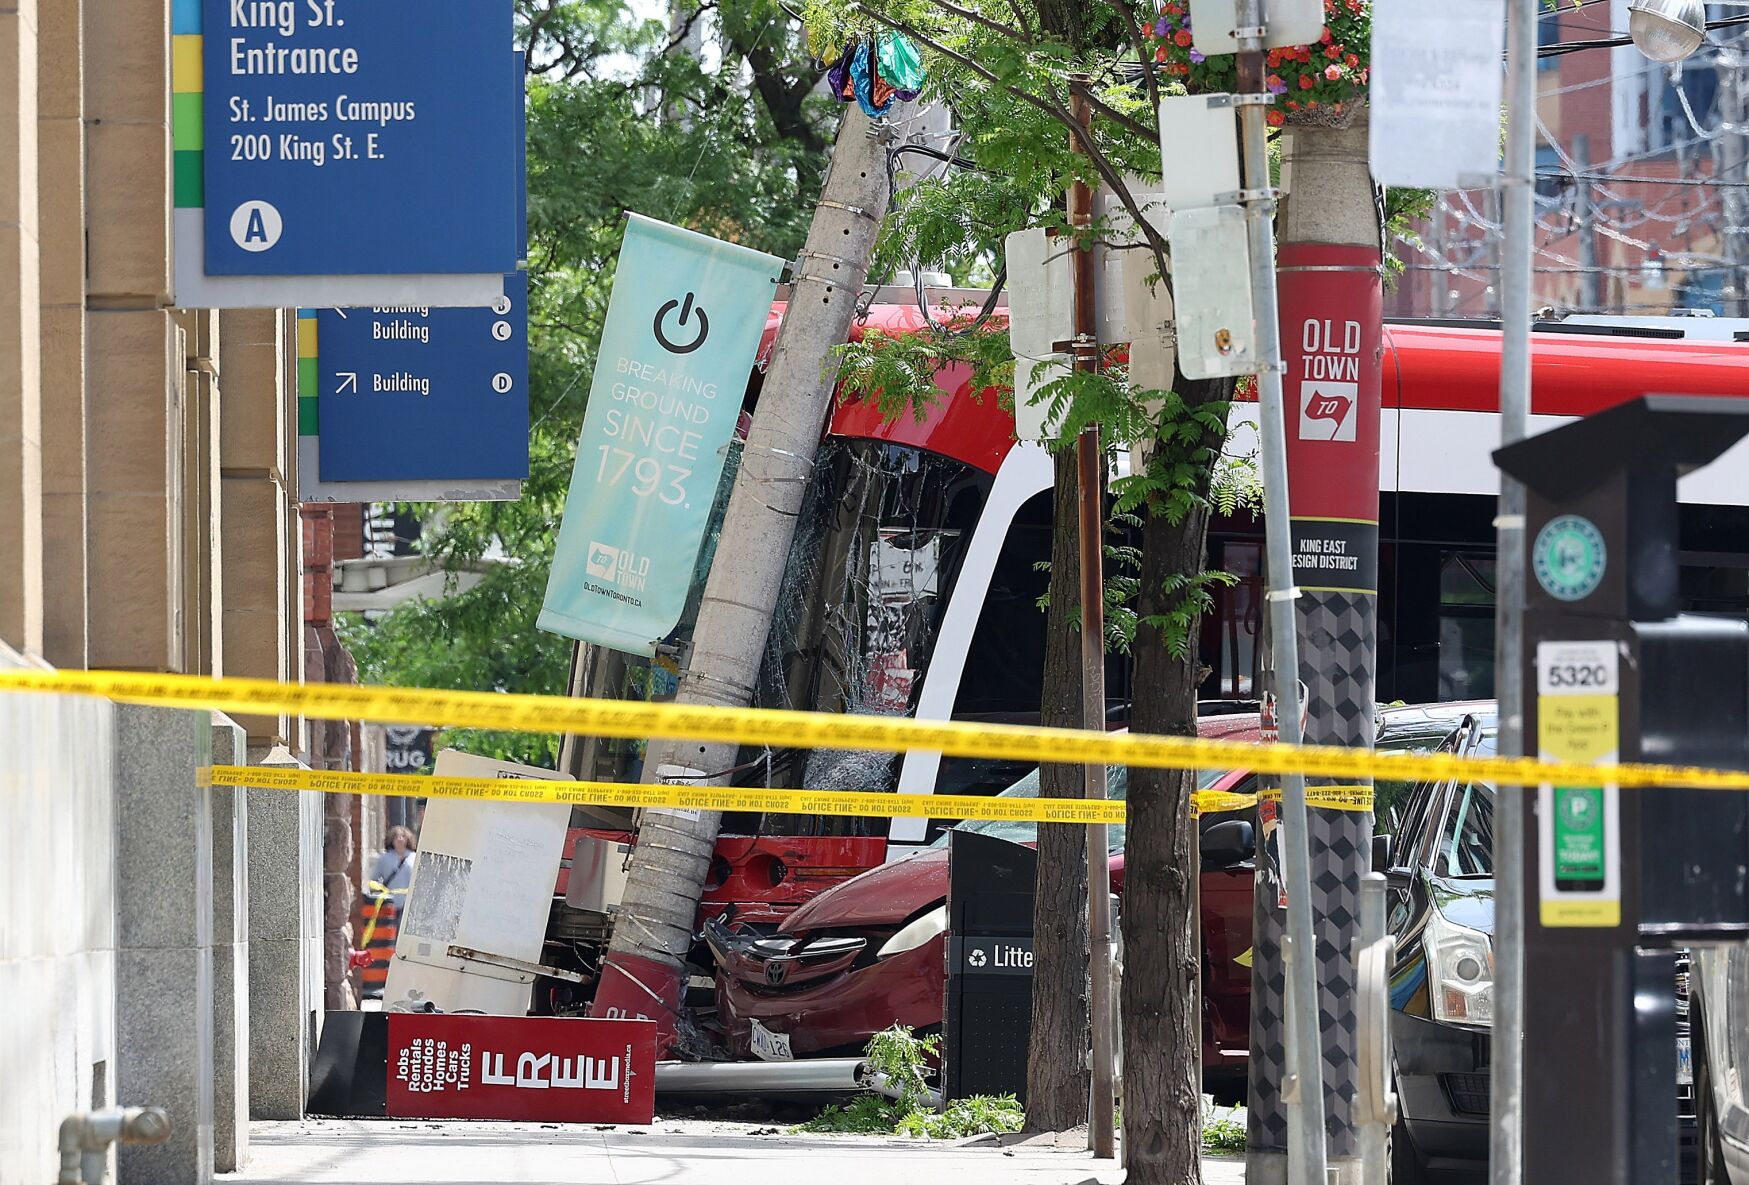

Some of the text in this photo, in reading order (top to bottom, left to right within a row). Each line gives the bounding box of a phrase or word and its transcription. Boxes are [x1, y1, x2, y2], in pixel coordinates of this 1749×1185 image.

[230, 0, 344, 36] King St.
[230, 38, 359, 74] Entrance
[229, 94, 416, 127] St. James Campus
[230, 133, 385, 167] 200 King St. E.
[244, 208, 268, 243] A
[372, 319, 505, 344] Building C
[1302, 318, 1362, 354] OLD
[372, 372, 508, 396] Building D
[616, 356, 718, 400] BREAKING
[1302, 354, 1360, 382] TOWN
[611, 382, 710, 424] GROUND
[1317, 400, 1338, 415] TO
[602, 409, 704, 461] SINCE
[596, 444, 690, 510] 1793.
[618, 550, 650, 576] OLD
[1292, 554, 1358, 570] ESIGN DISTRICT
[1300, 539, 1346, 554] KING EAST
[616, 570, 646, 592] TOWN
[994, 944, 1034, 968] Litte
[396, 1048, 409, 1082] Jobs
[408, 1038, 422, 1092] Rentals
[420, 1038, 434, 1093] Condos
[433, 1040, 447, 1091] Homes
[446, 1050, 458, 1084] Cars
[457, 1043, 471, 1090] Trucks
[482, 1050, 620, 1090] FREE
